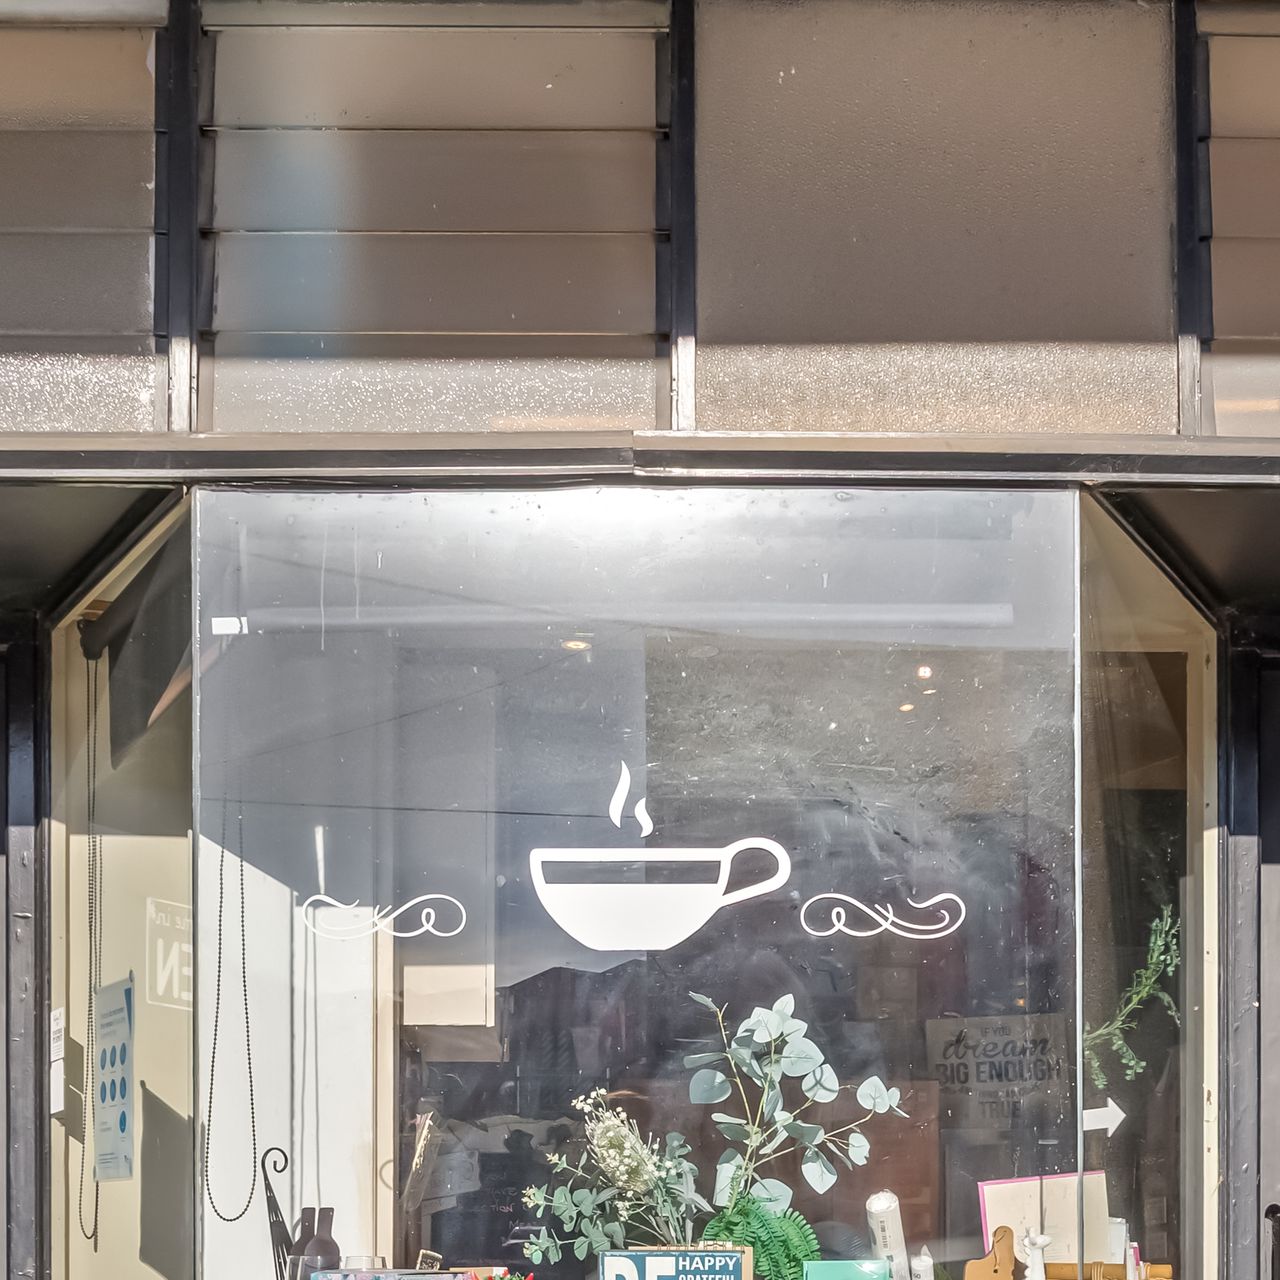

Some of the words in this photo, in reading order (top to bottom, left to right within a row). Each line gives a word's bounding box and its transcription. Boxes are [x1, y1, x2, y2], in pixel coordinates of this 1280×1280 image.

[942, 1028, 1051, 1060] dream
[935, 1062, 969, 1084] BIG
[678, 1256, 738, 1271] HAPPY
